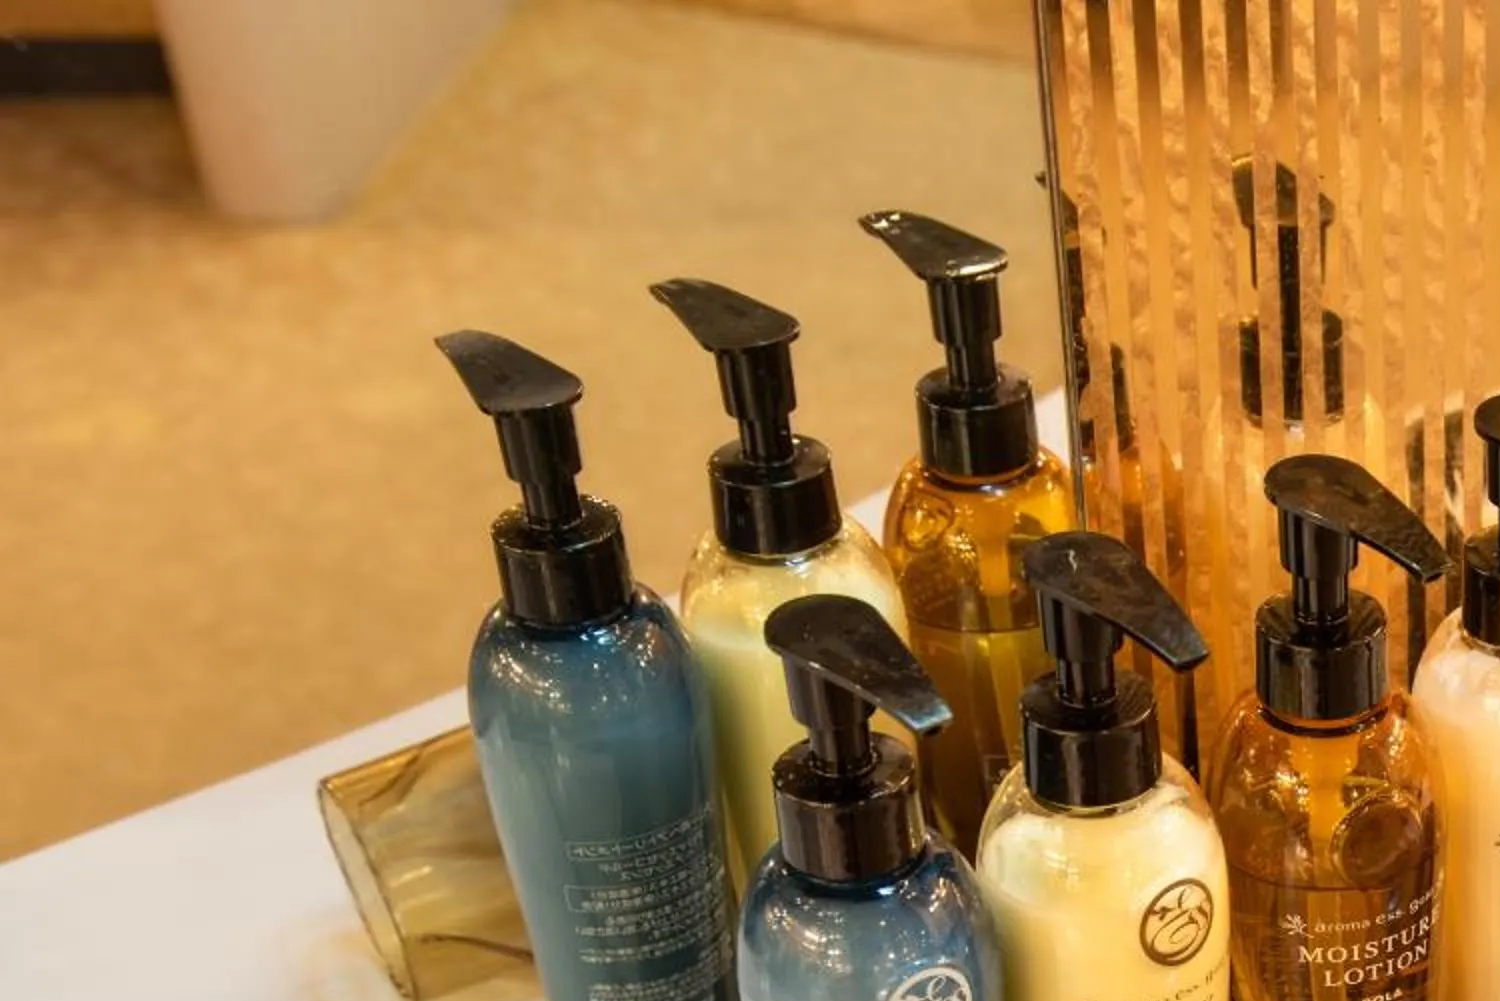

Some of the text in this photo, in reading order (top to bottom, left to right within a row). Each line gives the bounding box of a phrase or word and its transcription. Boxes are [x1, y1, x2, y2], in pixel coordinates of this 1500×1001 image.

[1298, 903, 1440, 963] MOISTURE
[1314, 919, 1371, 933] aroma
[1324, 939, 1428, 987] LOTION
